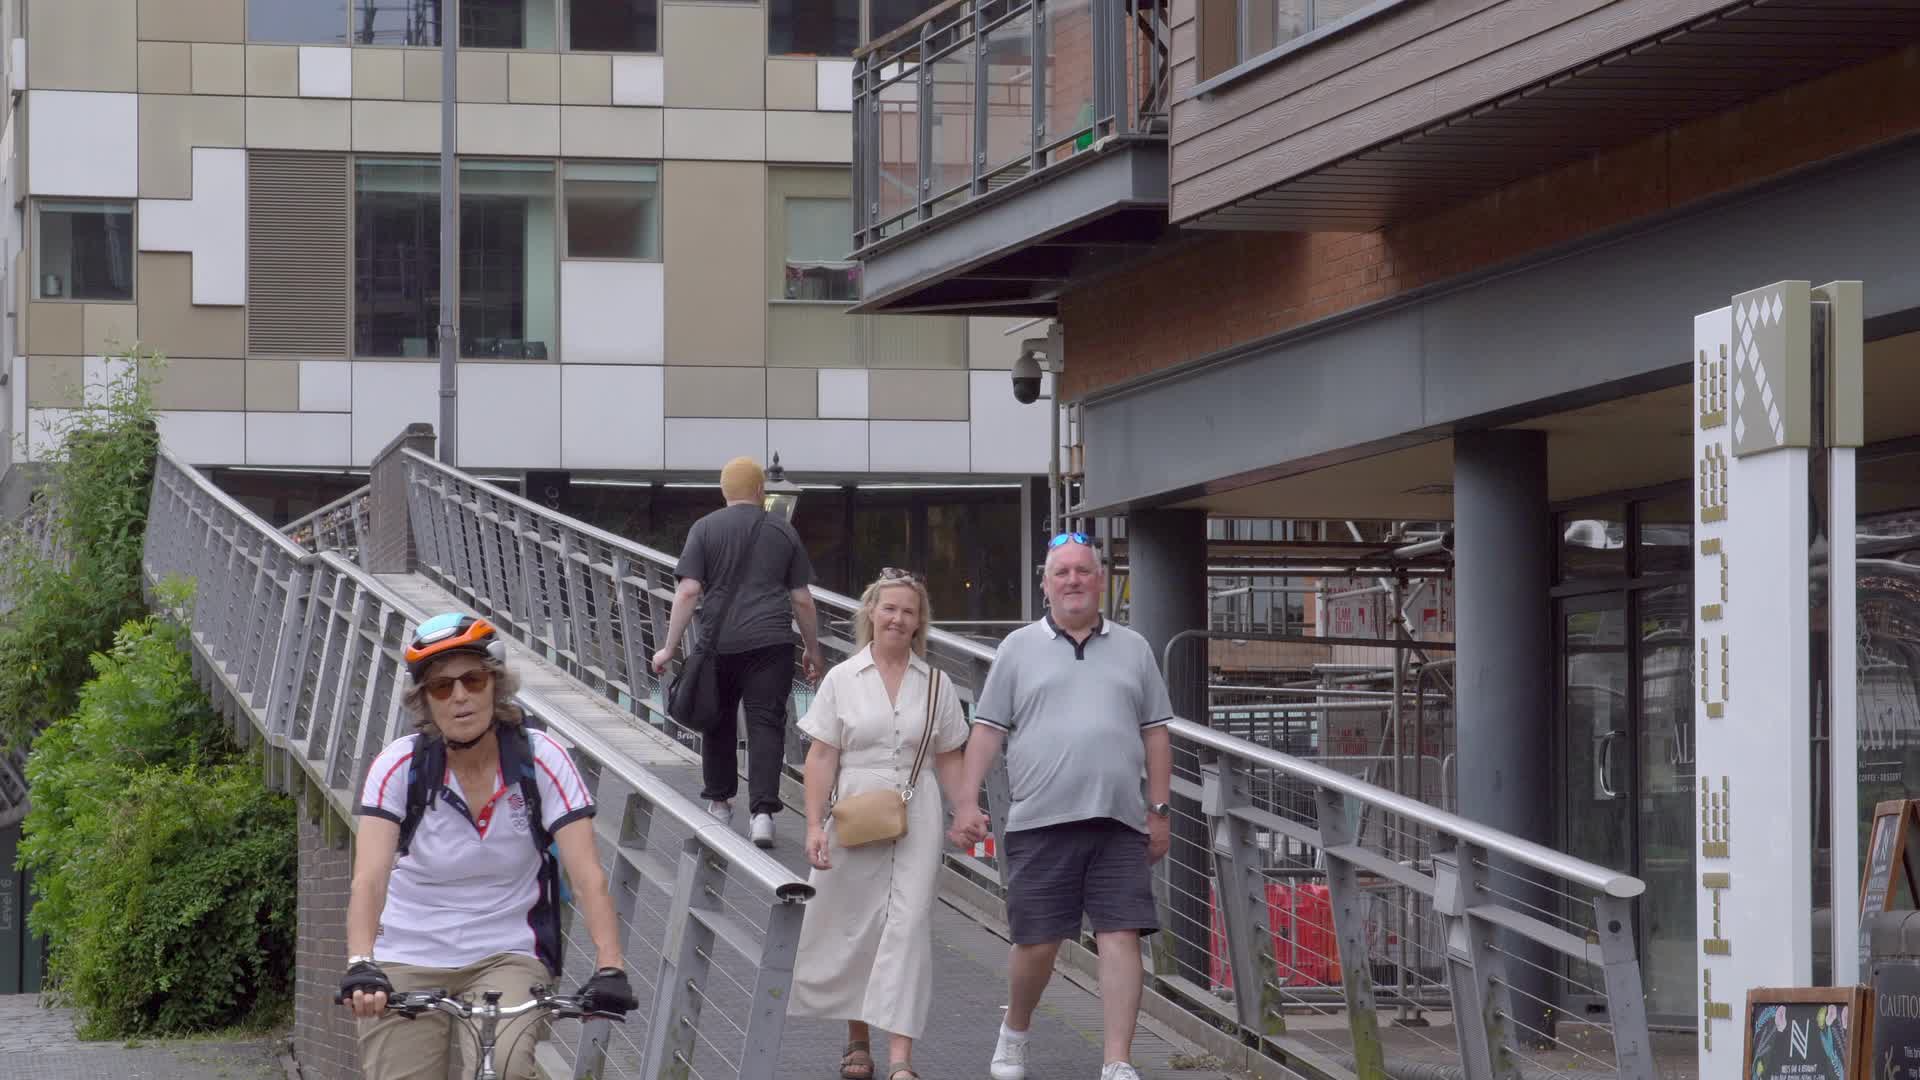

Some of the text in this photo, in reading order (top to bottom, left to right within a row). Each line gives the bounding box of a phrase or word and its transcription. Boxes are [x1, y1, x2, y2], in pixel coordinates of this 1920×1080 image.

[1700, 343, 1731, 1052] THE CUBE
[0, 879, 12, 930] Level 6
[1880, 993, 1920, 1017] CAUTIO
